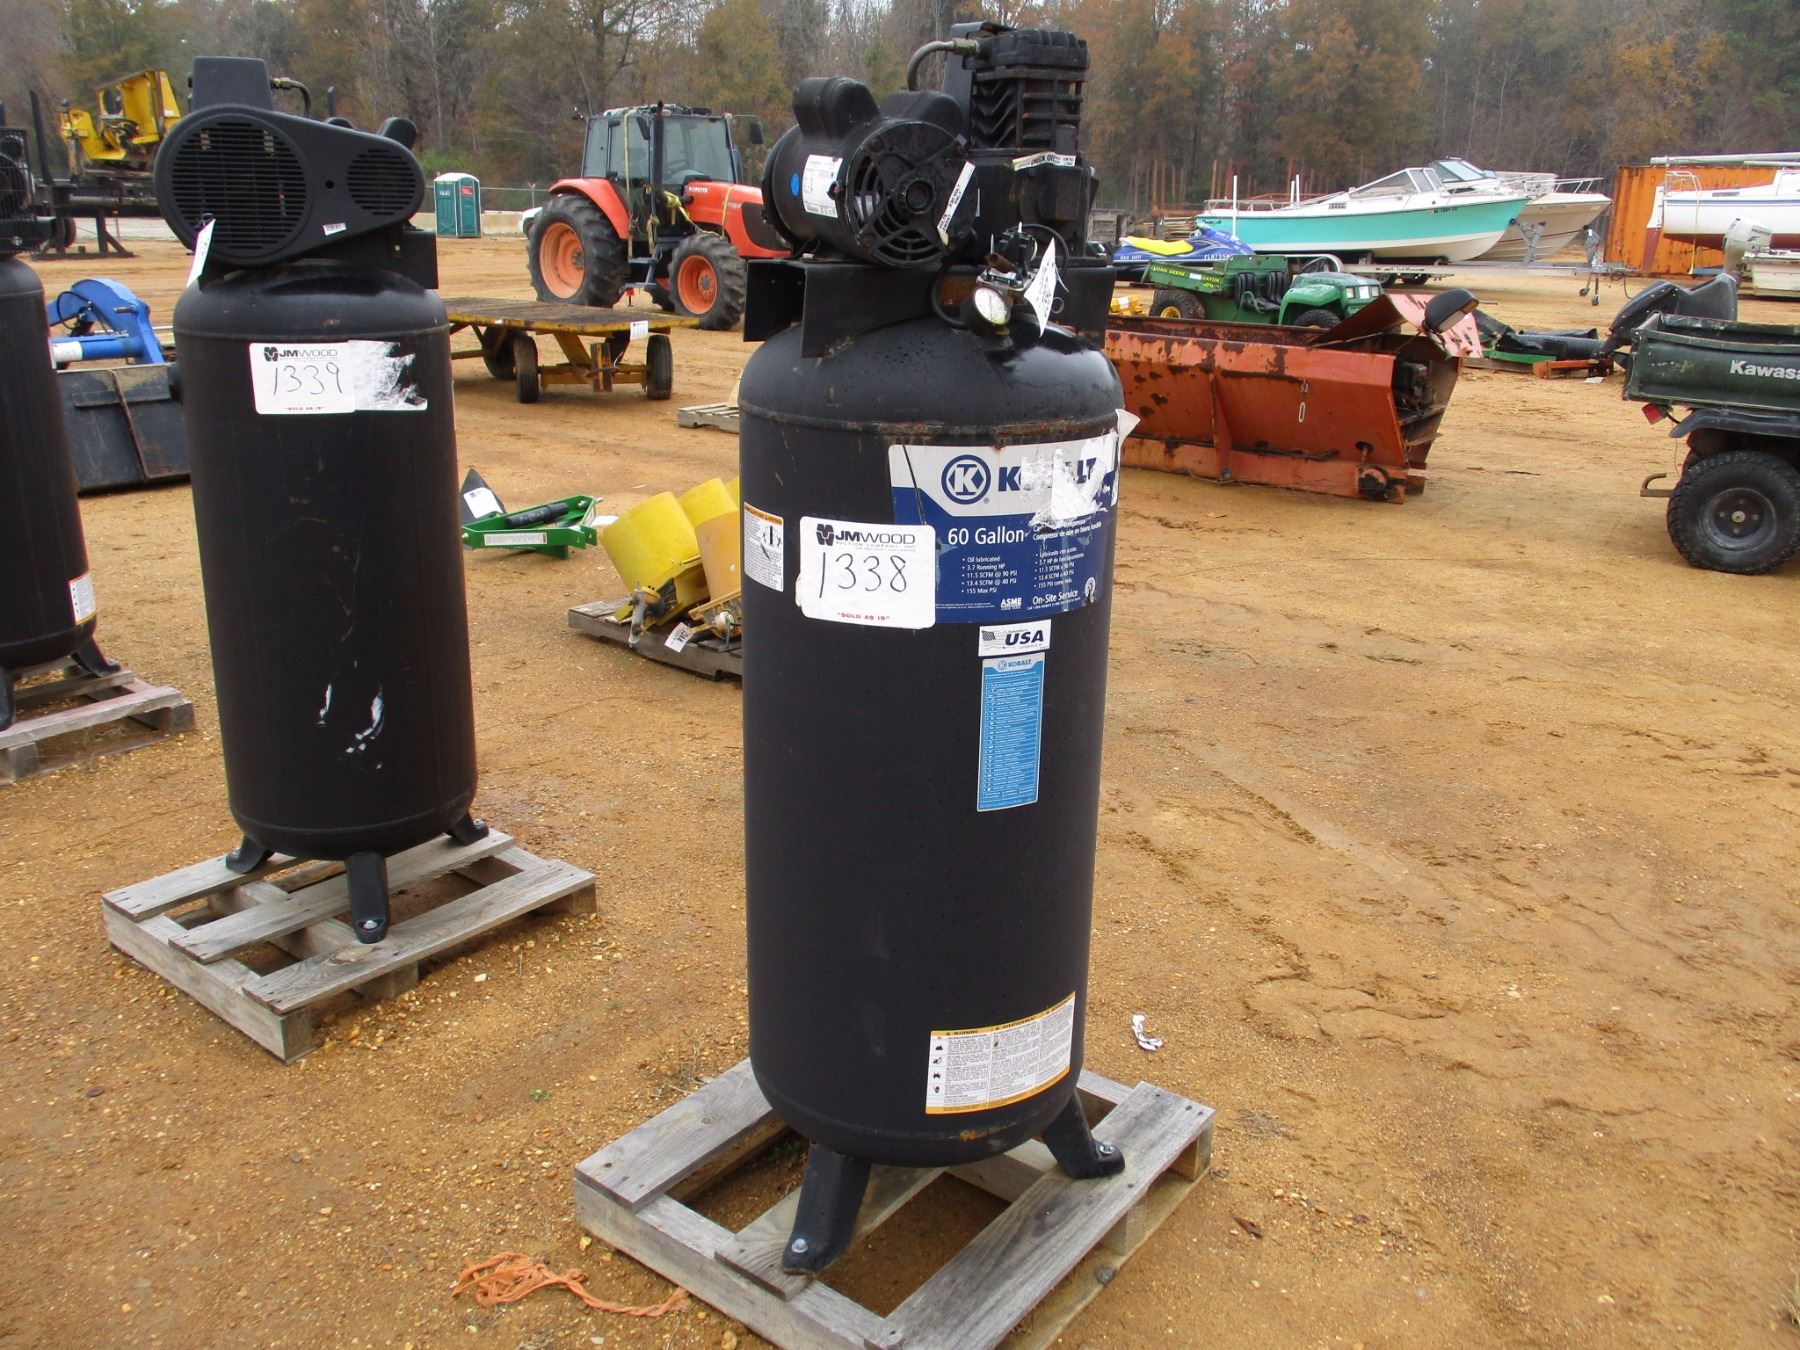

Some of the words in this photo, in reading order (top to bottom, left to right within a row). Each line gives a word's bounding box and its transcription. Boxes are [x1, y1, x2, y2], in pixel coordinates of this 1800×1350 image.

[273, 361, 343, 396] 1339
[948, 527, 969, 545] 60
[974, 525, 1025, 545] Gallon
[819, 552, 907, 599] 1338
[1001, 597, 1022, 607] ASME
[1032, 593, 1057, 605] On-Site
[1058, 590, 1078, 601] Service
[1005, 630, 1044, 646] USA
[1008, 659, 1032, 668] KOBALT
